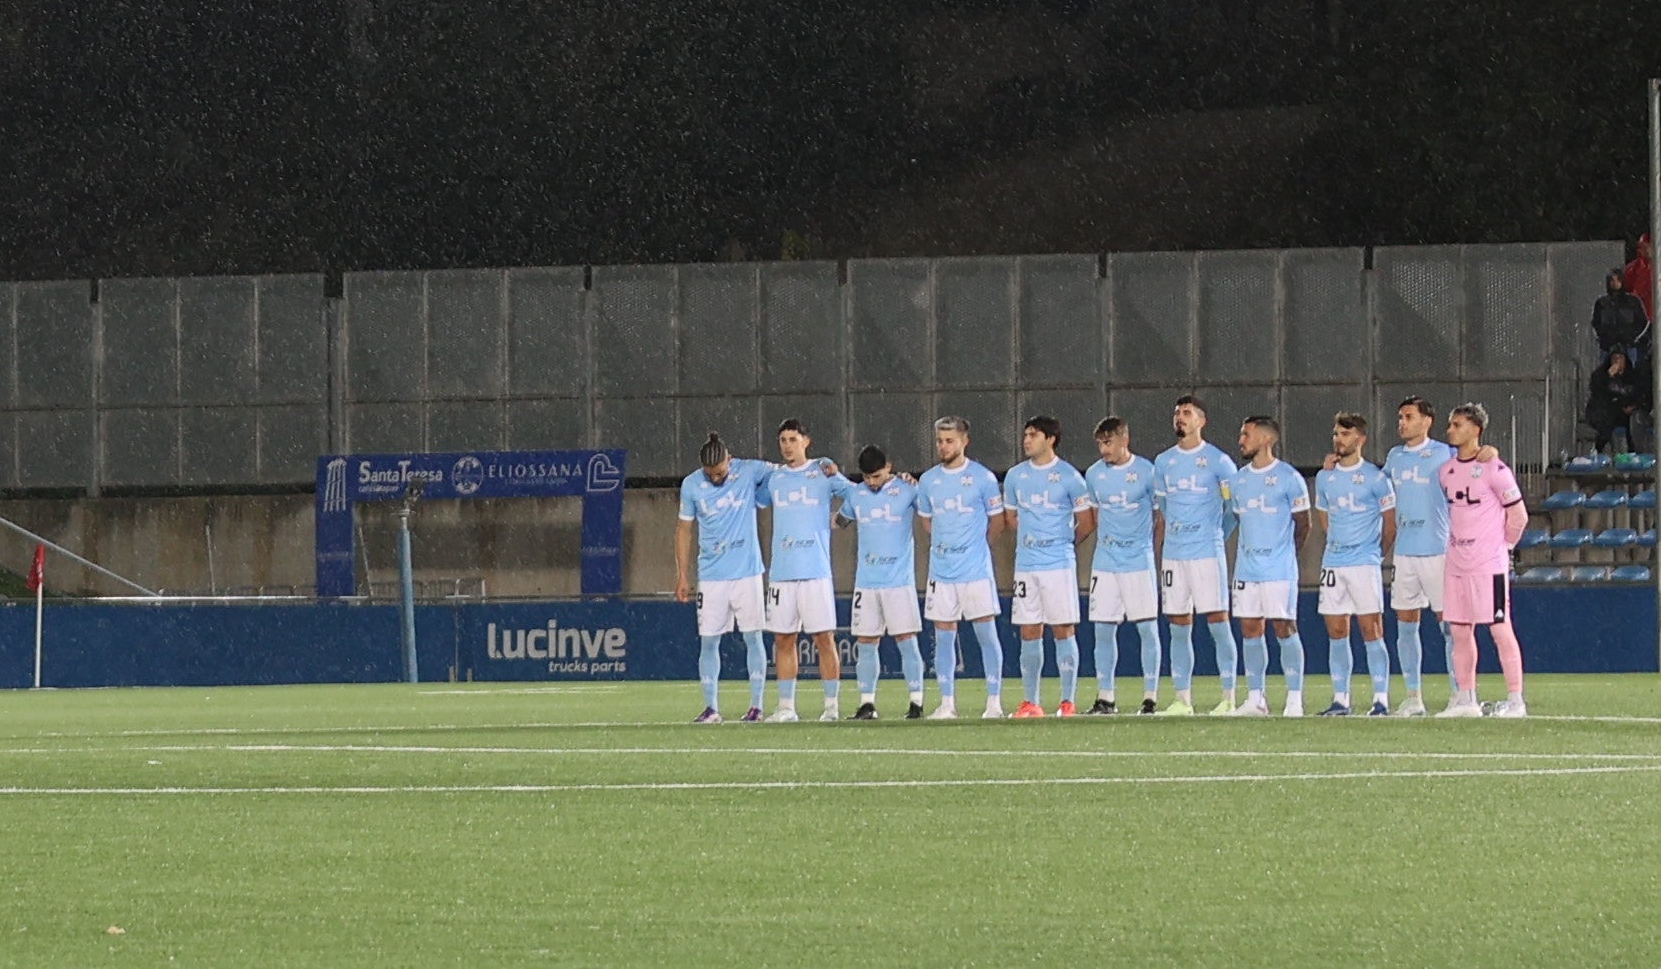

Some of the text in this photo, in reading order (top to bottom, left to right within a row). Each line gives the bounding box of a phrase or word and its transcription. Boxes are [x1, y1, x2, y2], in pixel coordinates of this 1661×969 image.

[854, 591, 862, 609] 2
[548, 660, 626, 675] trucks parts
